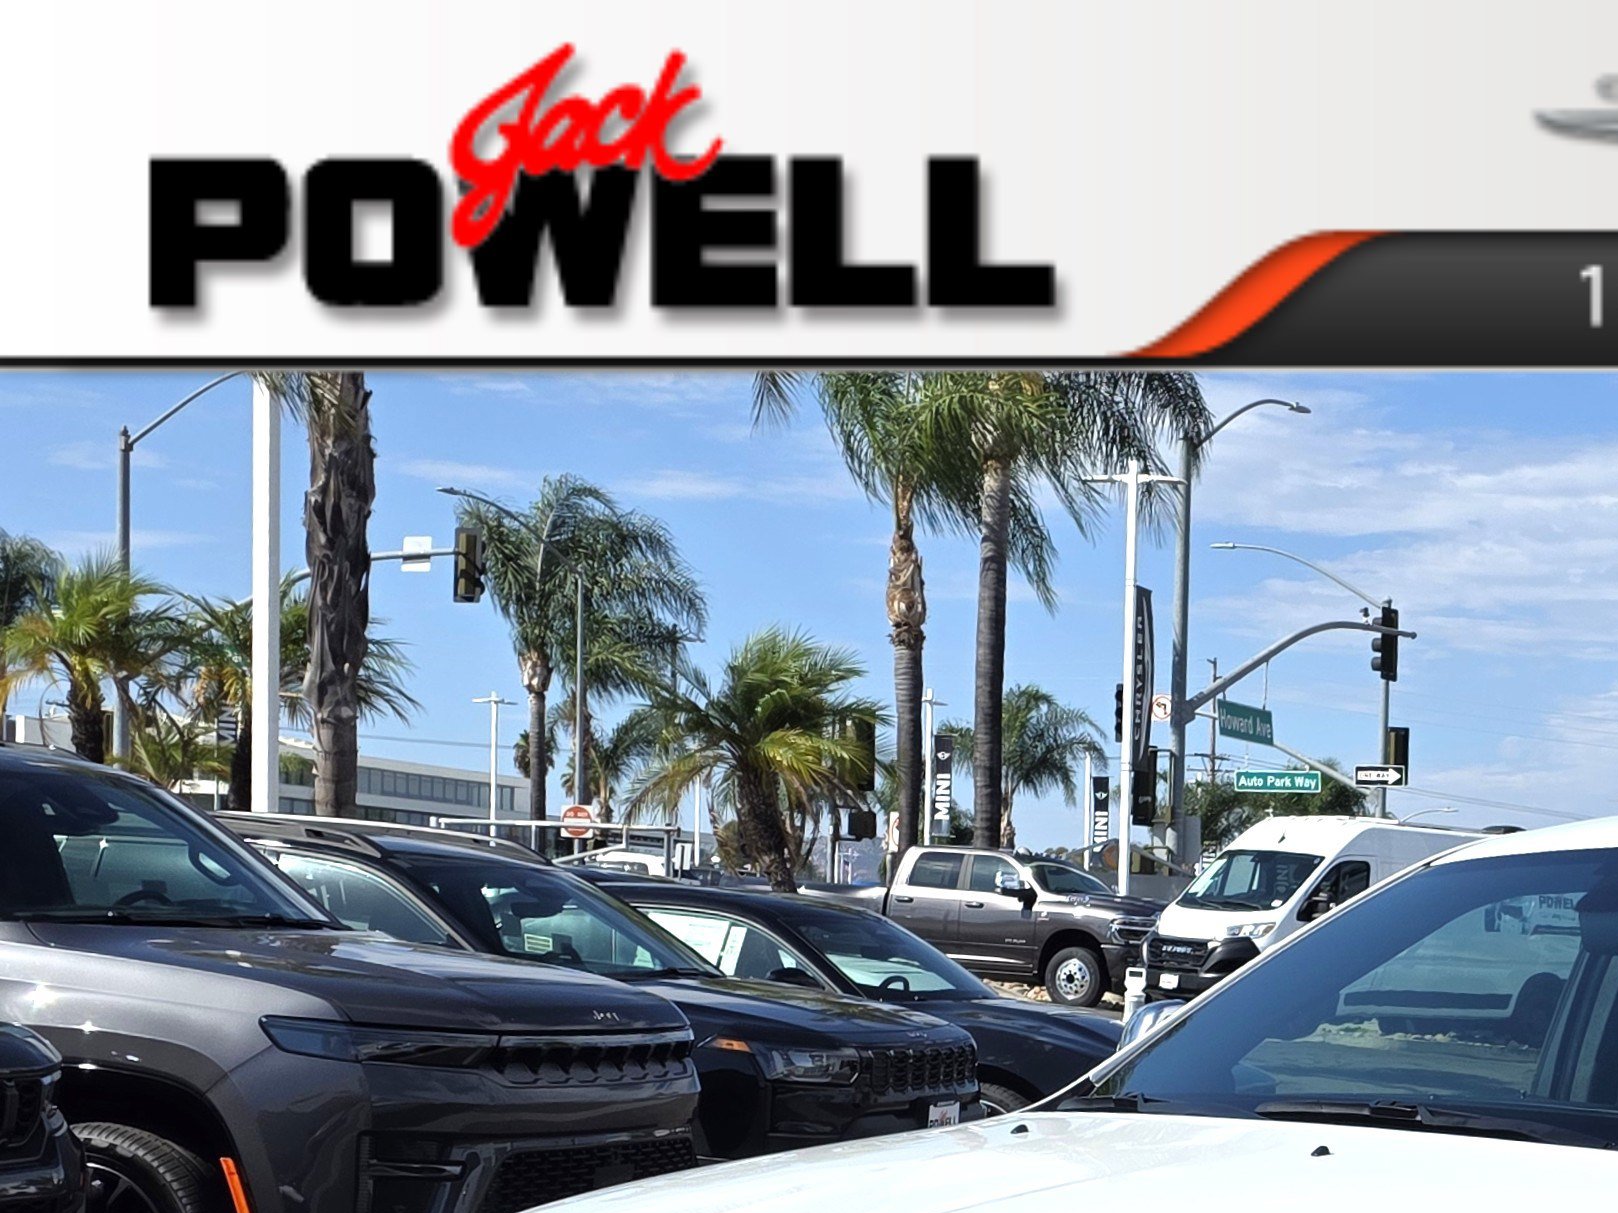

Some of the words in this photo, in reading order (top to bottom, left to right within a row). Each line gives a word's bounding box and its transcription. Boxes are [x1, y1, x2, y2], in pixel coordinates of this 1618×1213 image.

[1134, 616, 1145, 741] CHRYSLER
[1219, 707, 1254, 735] Howard
[1255, 716, 1272, 739] Ave
[934, 773, 951, 820] MINI
[1238, 775, 1264, 787] Auto
[1266, 775, 1292, 788] Park
[1293, 776, 1317, 790] Way
